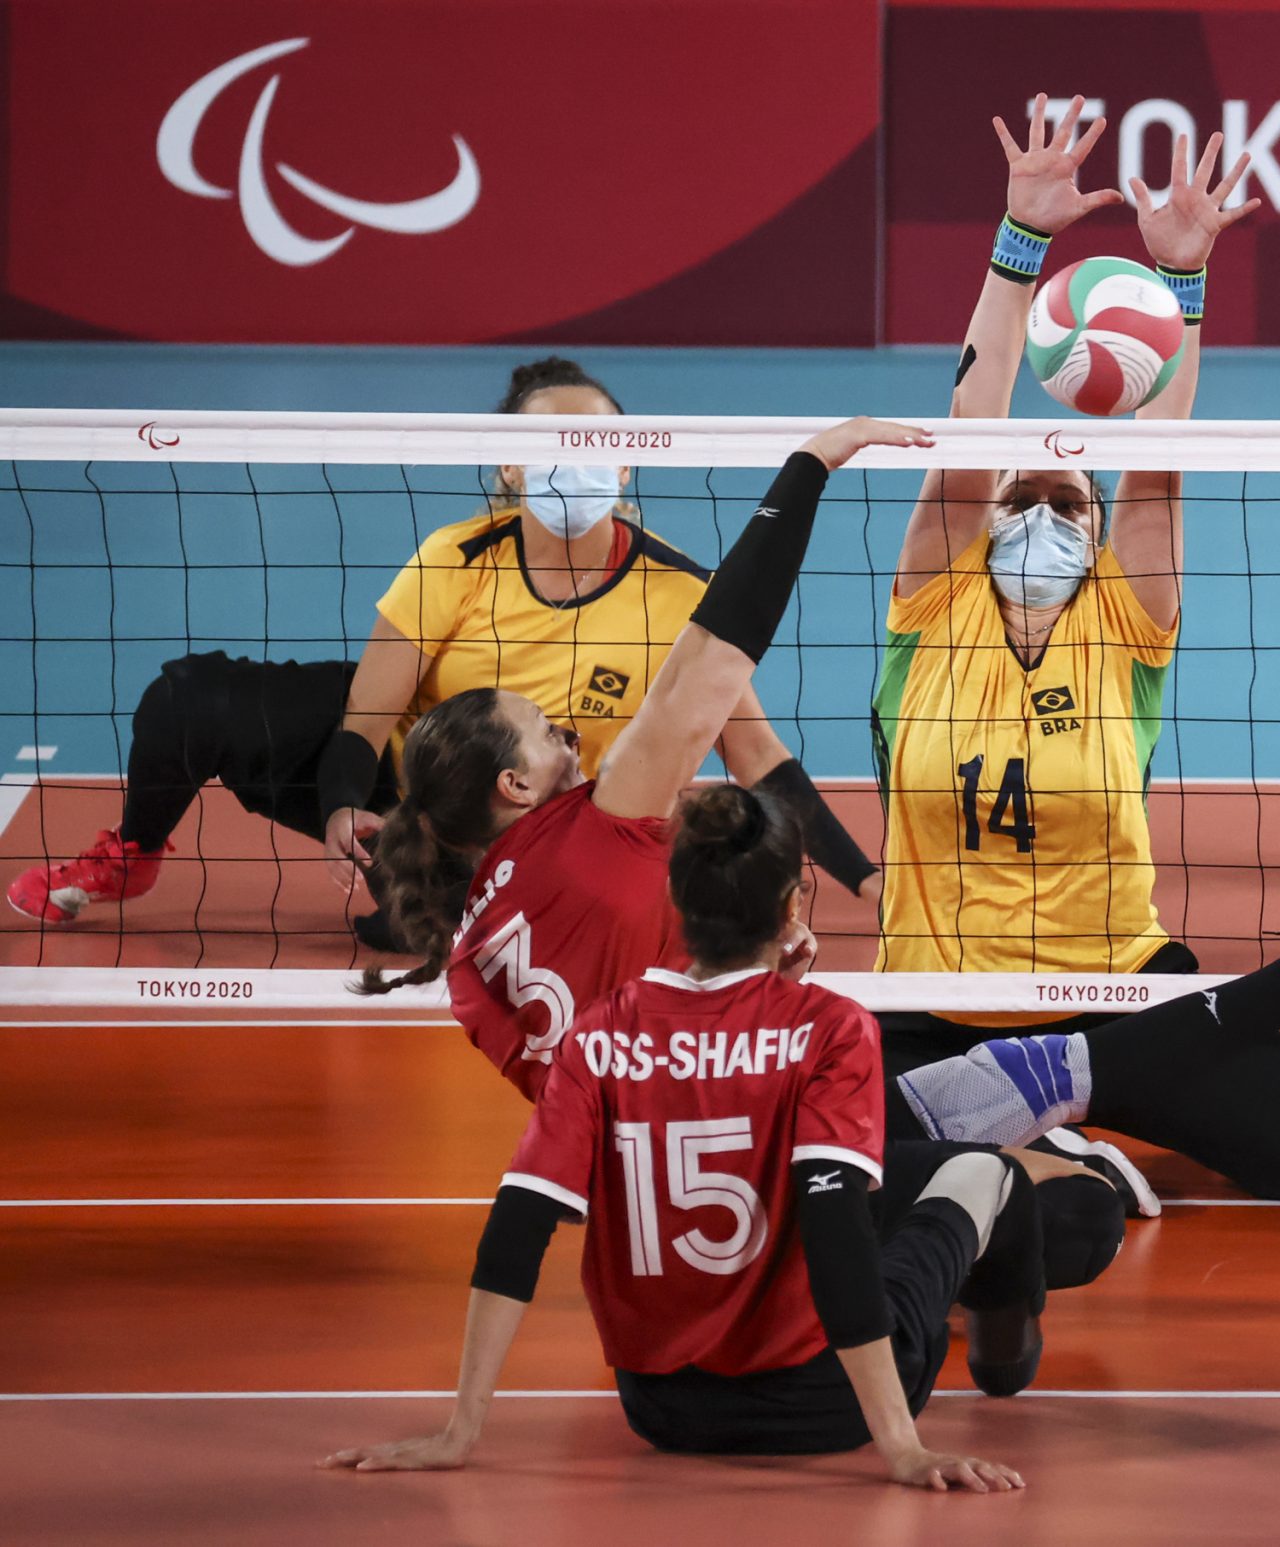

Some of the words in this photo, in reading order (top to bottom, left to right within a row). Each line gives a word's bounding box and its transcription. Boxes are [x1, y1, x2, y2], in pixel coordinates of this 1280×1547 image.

[557, 431, 621, 448] TOKYO
[625, 432, 672, 448] 2020
[581, 696, 614, 718] BRA
[1040, 717, 1082, 737] BRA
[958, 754, 1036, 853] 14
[137, 980, 201, 998] TOKYO
[206, 981, 253, 998] 2020
[472, 910, 575, 1066] 3
[1036, 985, 1098, 1002] TOKYO
[1103, 986, 1149, 1002] 2020
[615, 1117, 768, 1276] 15
